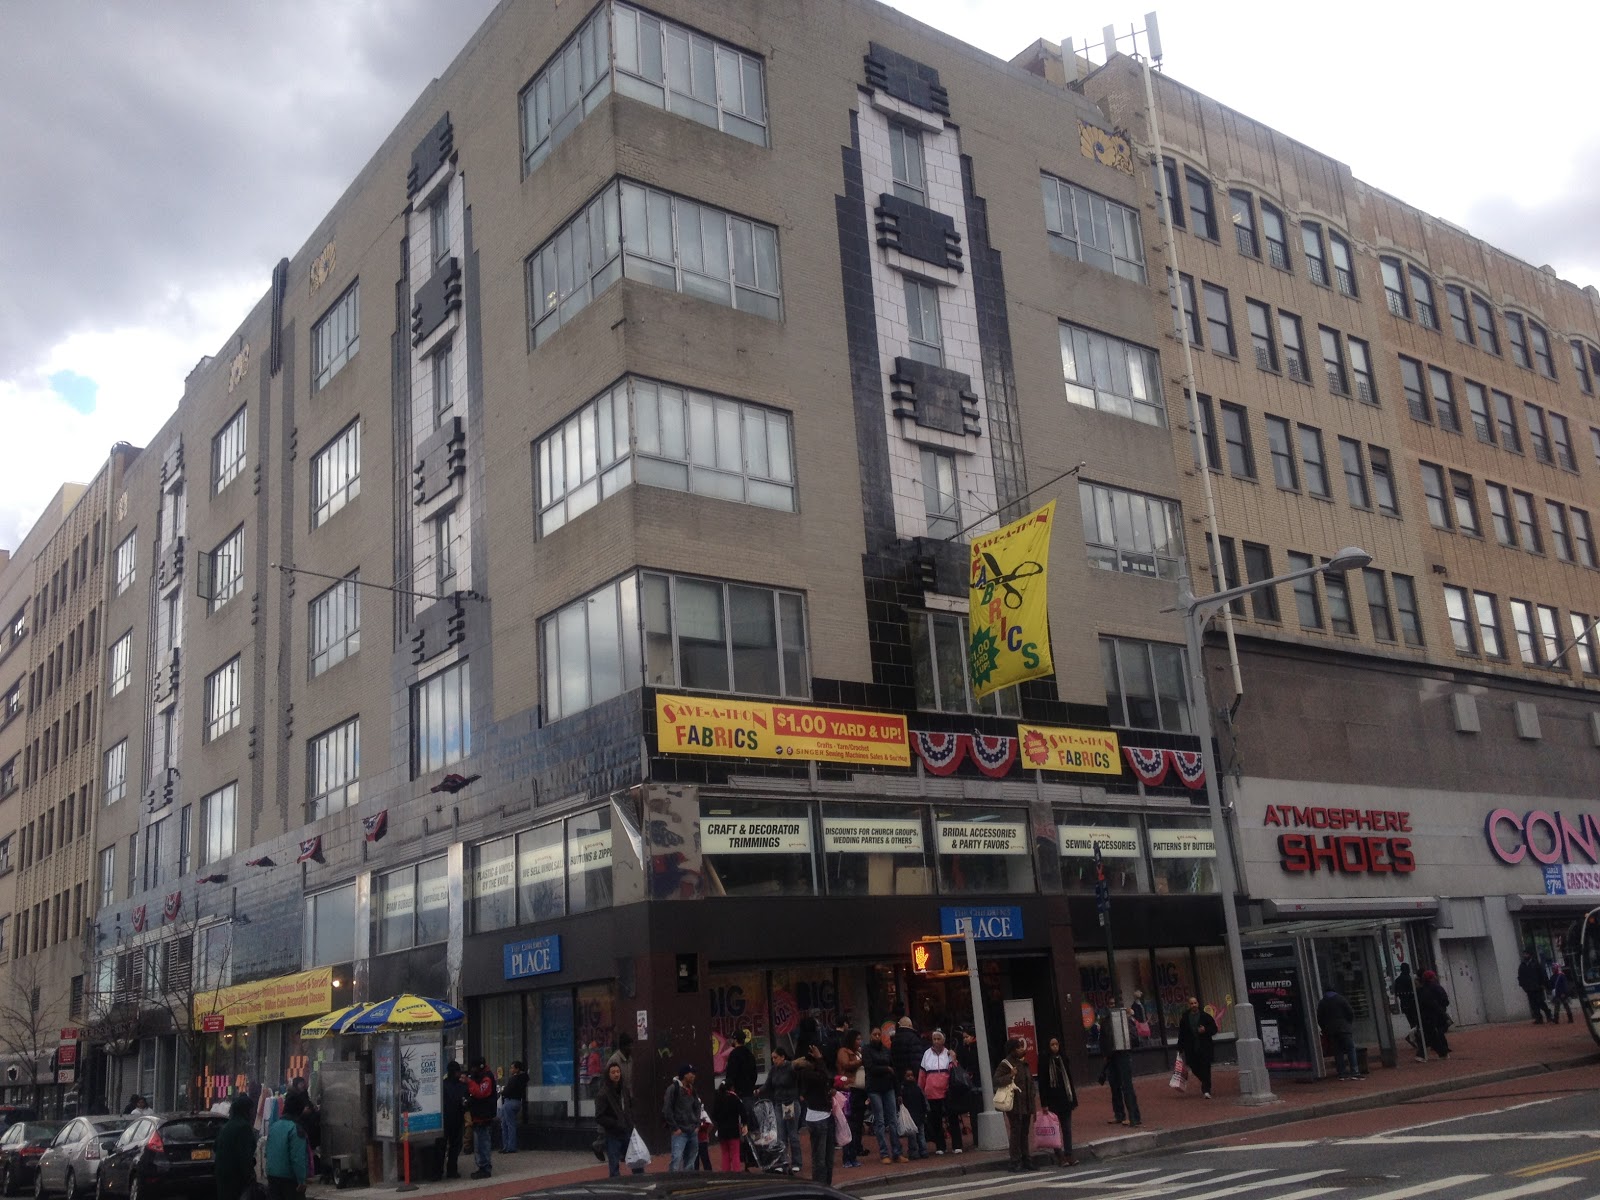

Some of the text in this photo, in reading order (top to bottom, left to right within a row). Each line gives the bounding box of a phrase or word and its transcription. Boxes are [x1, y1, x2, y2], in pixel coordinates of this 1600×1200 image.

[972, 558, 1040, 669] FABRICS
[663, 704, 767, 730] SAVE-A-THON
[777, 713, 901, 740] $1.00 YARD & UP!
[675, 725, 758, 750] FABRICS
[1049, 734, 1114, 753] SAVE-A-THON
[817, 741, 833, 749] Crafts
[836, 744, 869, 752] Yarn/Crochet
[796, 748, 824, 756] SINGER
[825, 750, 844, 759] Sewing
[845, 752, 869, 760] Machines
[1057, 750, 1110, 769] FABRICS
[1263, 804, 1413, 832] ATMOSPHERE
[707, 823, 800, 835] CRAFT & DECORATOR
[871, 828, 894, 836] CHURCH
[895, 829, 919, 837] GROUPS,
[942, 828, 1016, 839] BRIDAL ACCESSORIES
[729, 837, 780, 848] TRIMMINGS
[833, 836, 859, 844] WEDDING
[861, 836, 884, 844] PARTIES
[952, 839, 1009, 849] & PARTY FAVORS
[1065, 839, 1092, 849] SEWING
[1153, 842, 1182, 850] PATTERNS
[1183, 842, 1191, 850] BY
[593, 850, 597, 861] &
[1279, 833, 1416, 872] SHOES
[523, 868, 530, 878] WE
[530, 866, 540, 877] SELL
[1566, 872, 1594, 890] EASTER
[955, 917, 1013, 938] PACE
[512, 948, 551, 976] PLACE
[1251, 980, 1292, 990] UNLIMITED
[1014, 1017, 1031, 1027] sale
